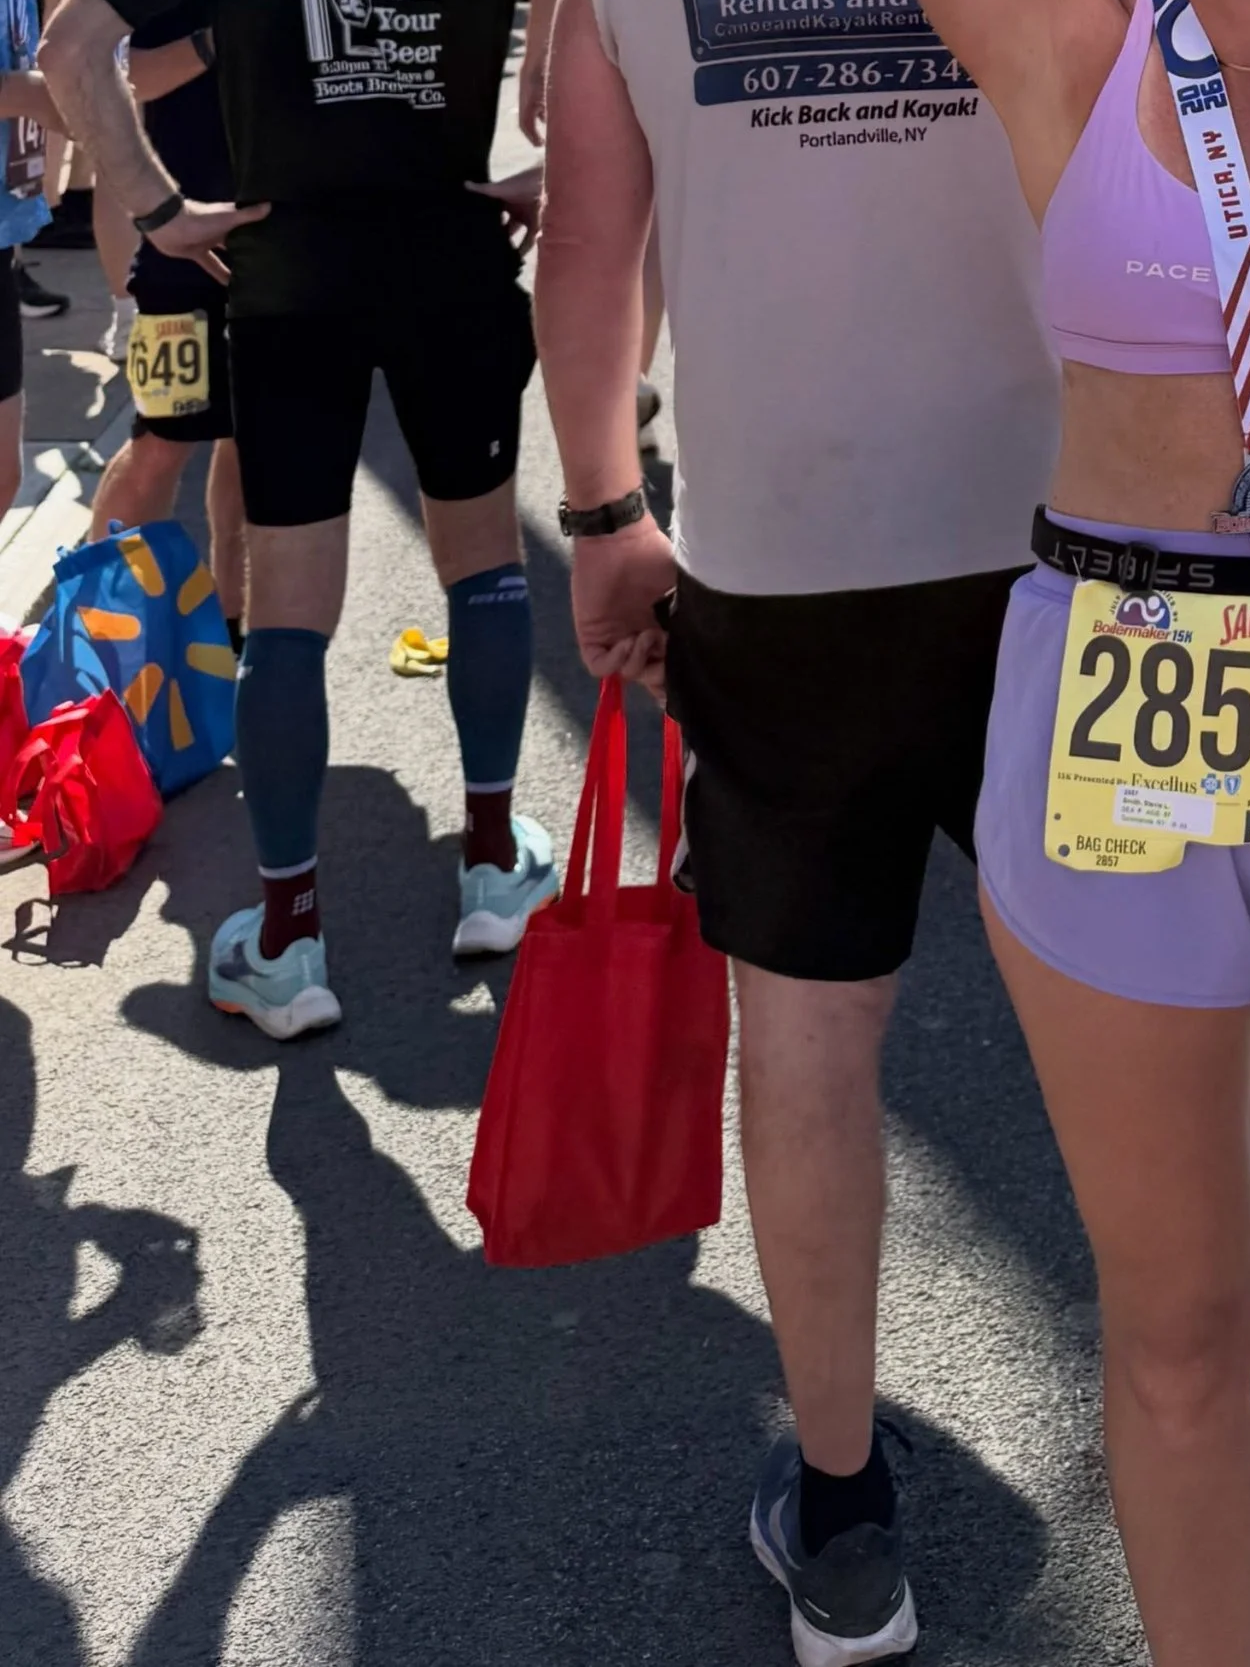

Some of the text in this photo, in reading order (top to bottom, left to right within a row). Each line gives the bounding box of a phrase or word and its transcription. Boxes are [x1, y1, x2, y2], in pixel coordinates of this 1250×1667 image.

[373, 6, 442, 32] Your
[715, 10, 929, 37] CanoeandKayakRent
[376, 38, 443, 63] Beer
[743, 58, 975, 93] 607-286-734
[314, 79, 364, 98] Boots
[750, 97, 979, 128] Kick Back and Kayak!
[904, 127, 928, 142] NY
[1125, 260, 1212, 283] PACE
[1092, 619, 1193, 643] Boilermaker 15K
[1131, 773, 1198, 795] Excellus
[1076, 835, 1147, 855] BAG CHECK
[1096, 854, 1119, 868] 2857
